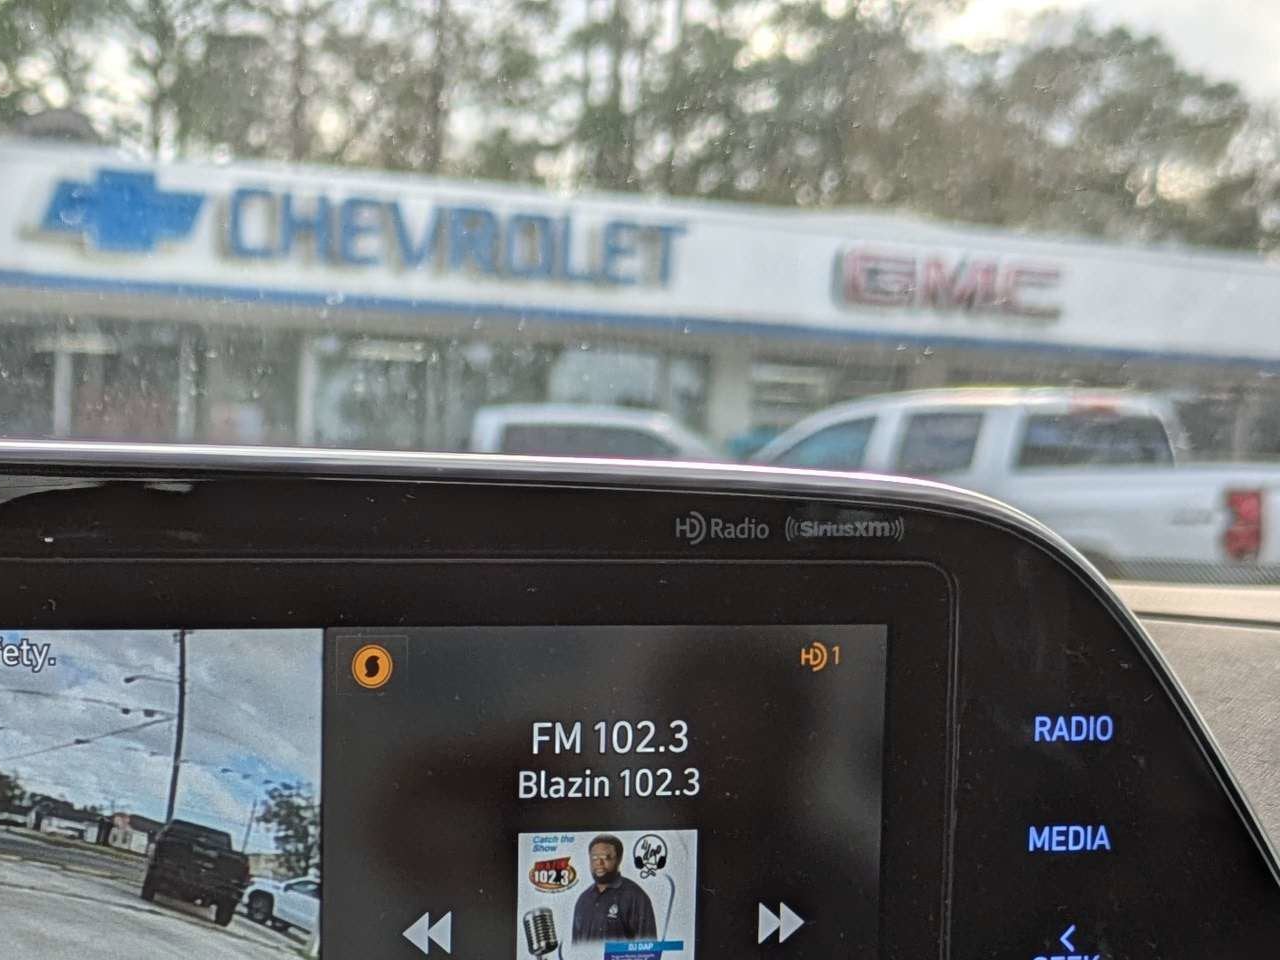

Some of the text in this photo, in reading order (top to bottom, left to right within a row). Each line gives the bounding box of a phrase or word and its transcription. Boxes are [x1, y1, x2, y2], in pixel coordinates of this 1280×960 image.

[222, 187, 687, 289] CHEVROLET
[837, 245, 1062, 320] GMC
[710, 516, 769, 539] Radio
[531, 719, 689, 755] FM 102.3
[1033, 715, 1114, 742] RADIO
[518, 767, 701, 799] Blazin 102.3
[1027, 825, 1112, 851] MEDIA
[627, 943, 654, 951] DJ DAP
